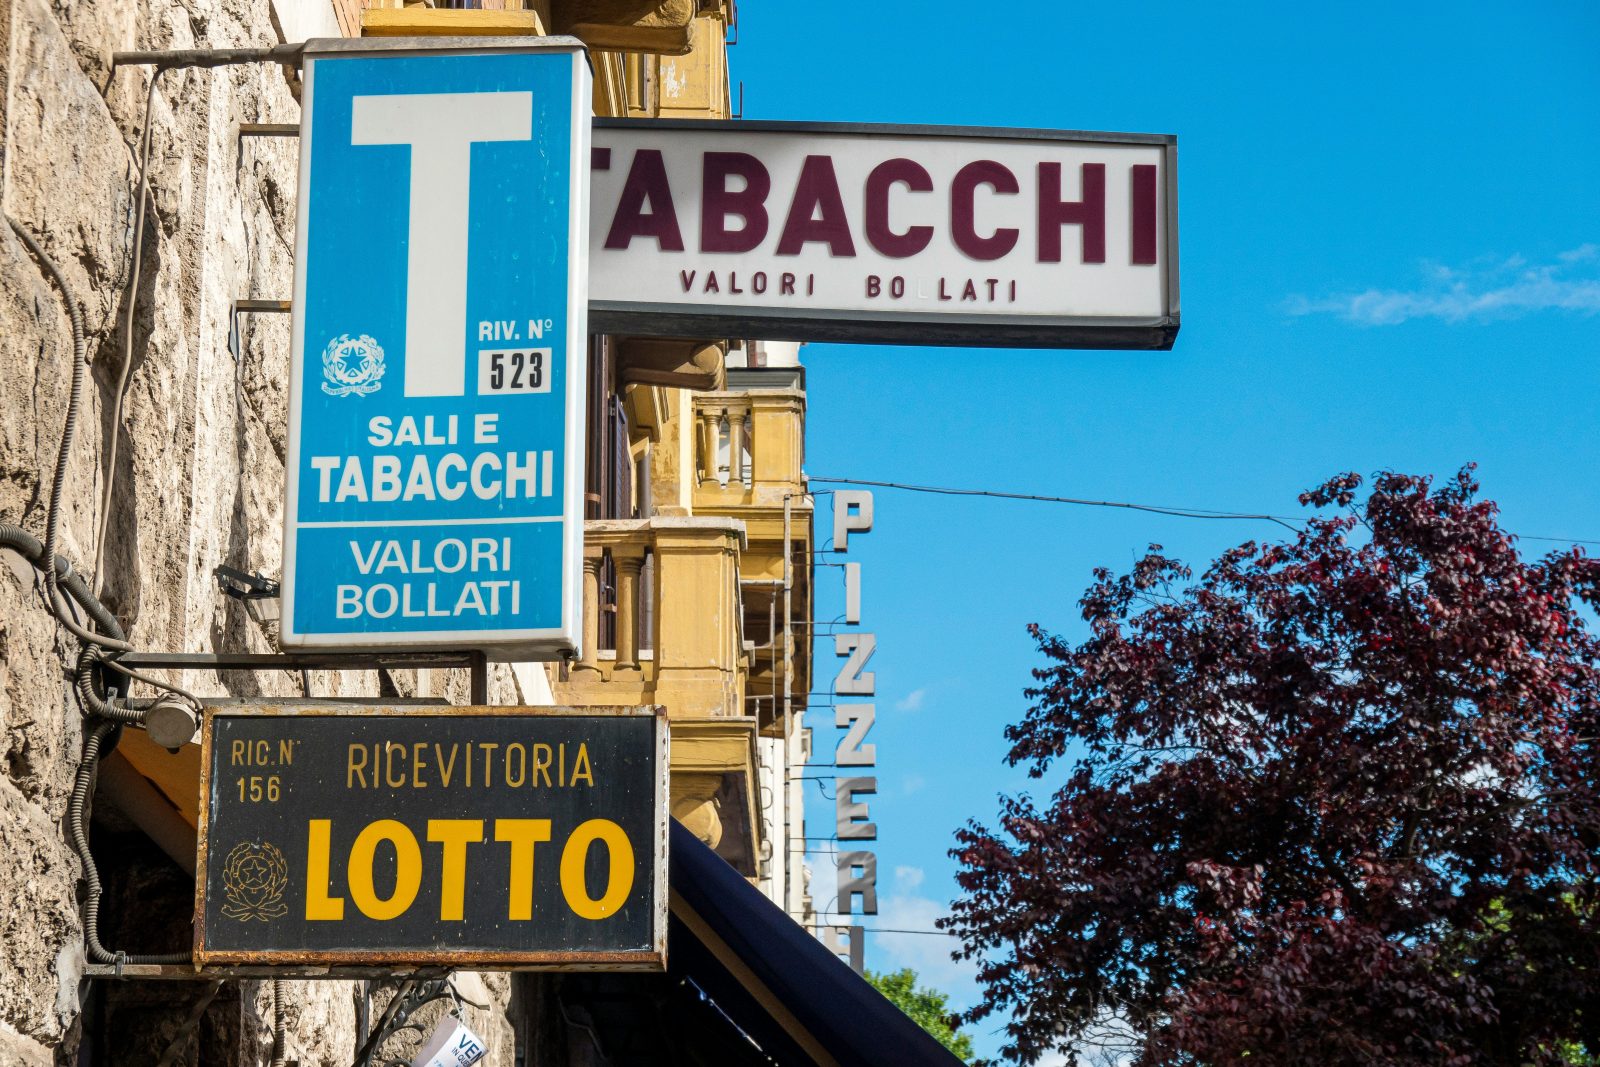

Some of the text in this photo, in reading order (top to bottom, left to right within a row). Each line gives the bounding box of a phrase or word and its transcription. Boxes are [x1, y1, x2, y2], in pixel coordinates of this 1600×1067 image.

[591, 147, 1157, 266] ABACCHI
[351, 90, 533, 398] T
[681, 269, 815, 297] VALORI
[478, 320, 520, 341] RIV.
[490, 351, 543, 390] 523
[367, 412, 499, 447] SALI E
[310, 450, 554, 504] TABACCHI
[349, 536, 511, 576] VALORI
[335, 579, 521, 620] BOLLATI
[346, 742, 595, 789] RICEVITORIA
[236, 775, 281, 803] 156
[305, 818, 636, 921] LOTTO
